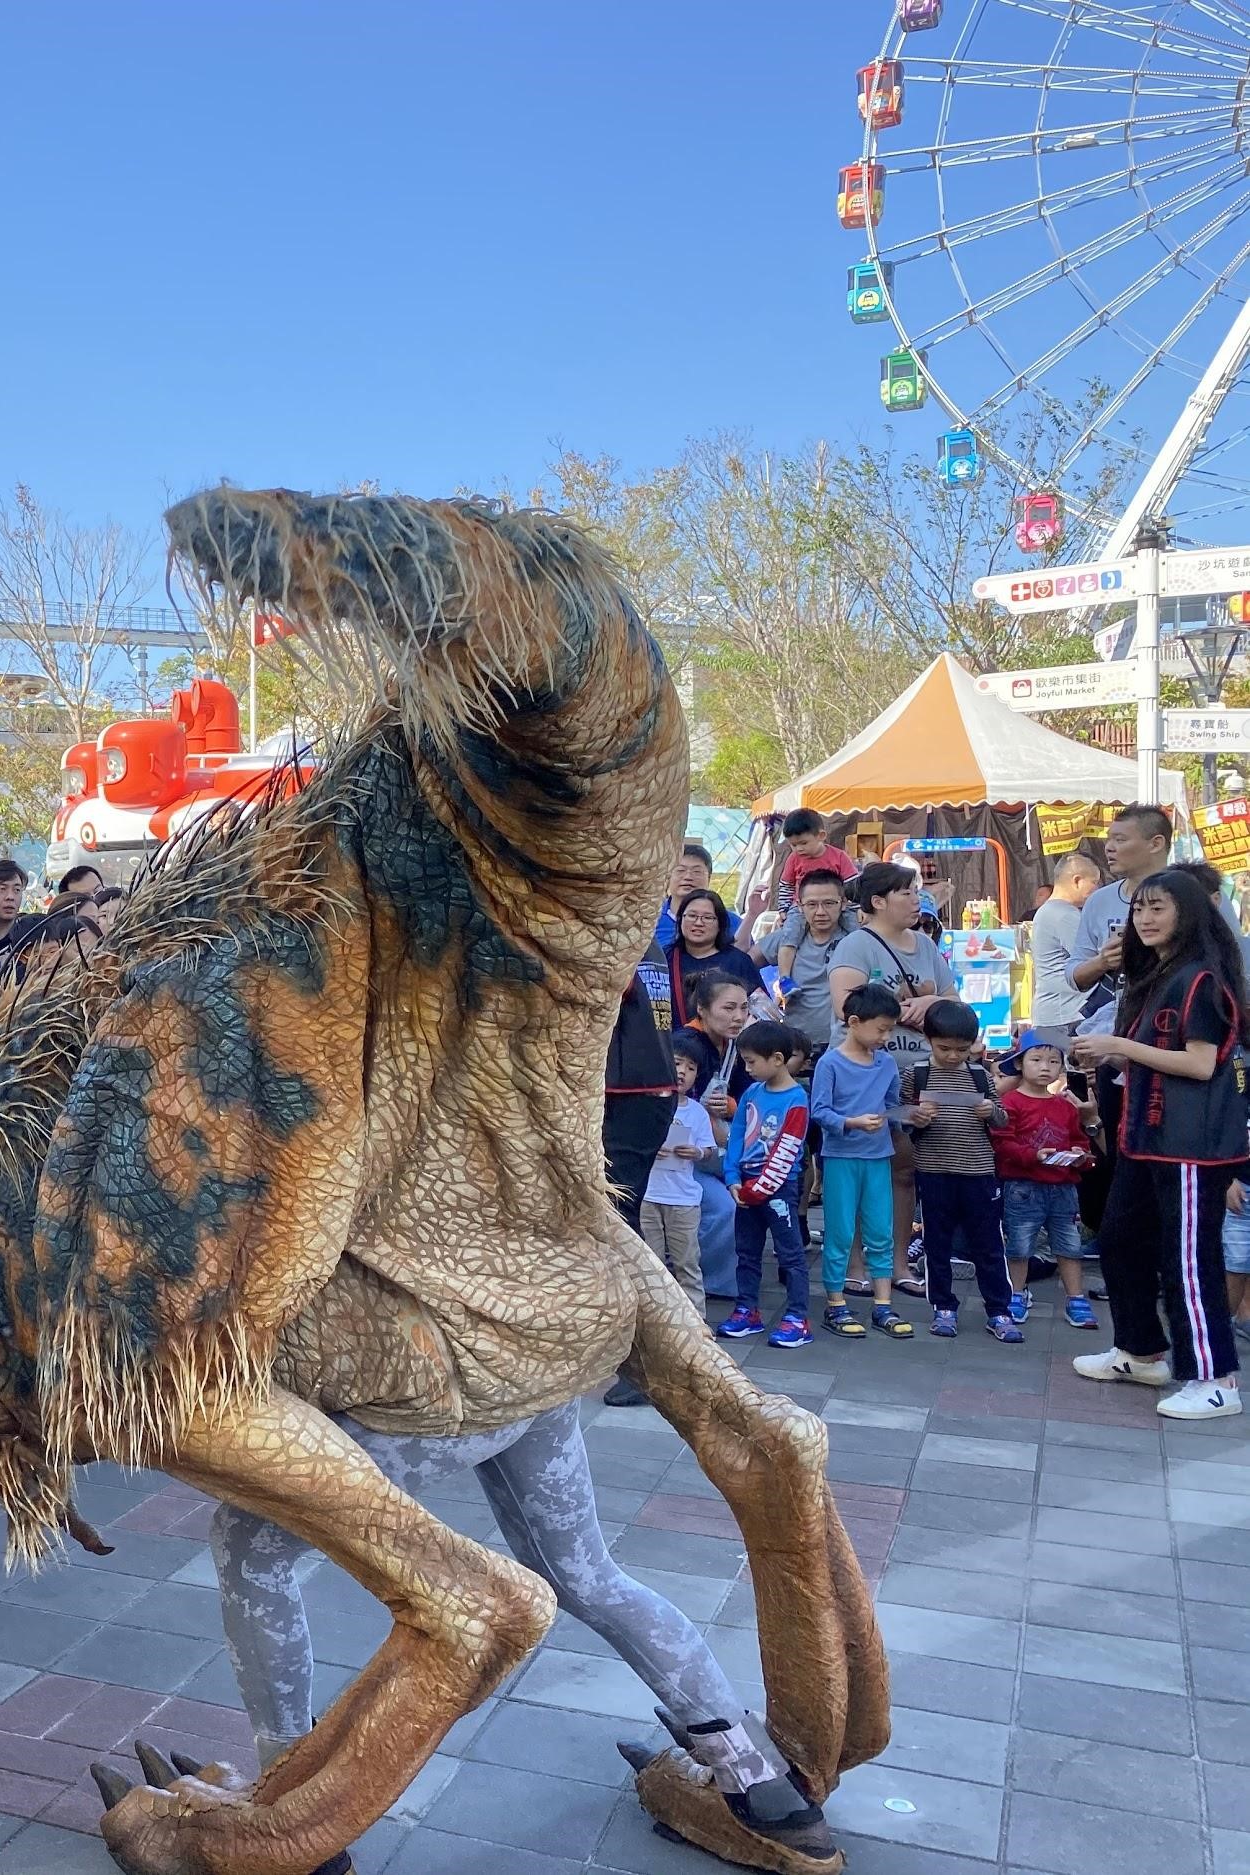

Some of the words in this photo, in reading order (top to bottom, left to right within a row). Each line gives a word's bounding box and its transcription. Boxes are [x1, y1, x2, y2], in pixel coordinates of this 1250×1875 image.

[1035, 672, 1101, 688] 歡樂市集街
[1036, 689, 1063, 699] Joyful
[1065, 686, 1096, 696] Market
[1190, 731, 1217, 739] Swing
[1220, 731, 1240, 739] Ship
[752, 1133, 802, 1195] MARVEL
